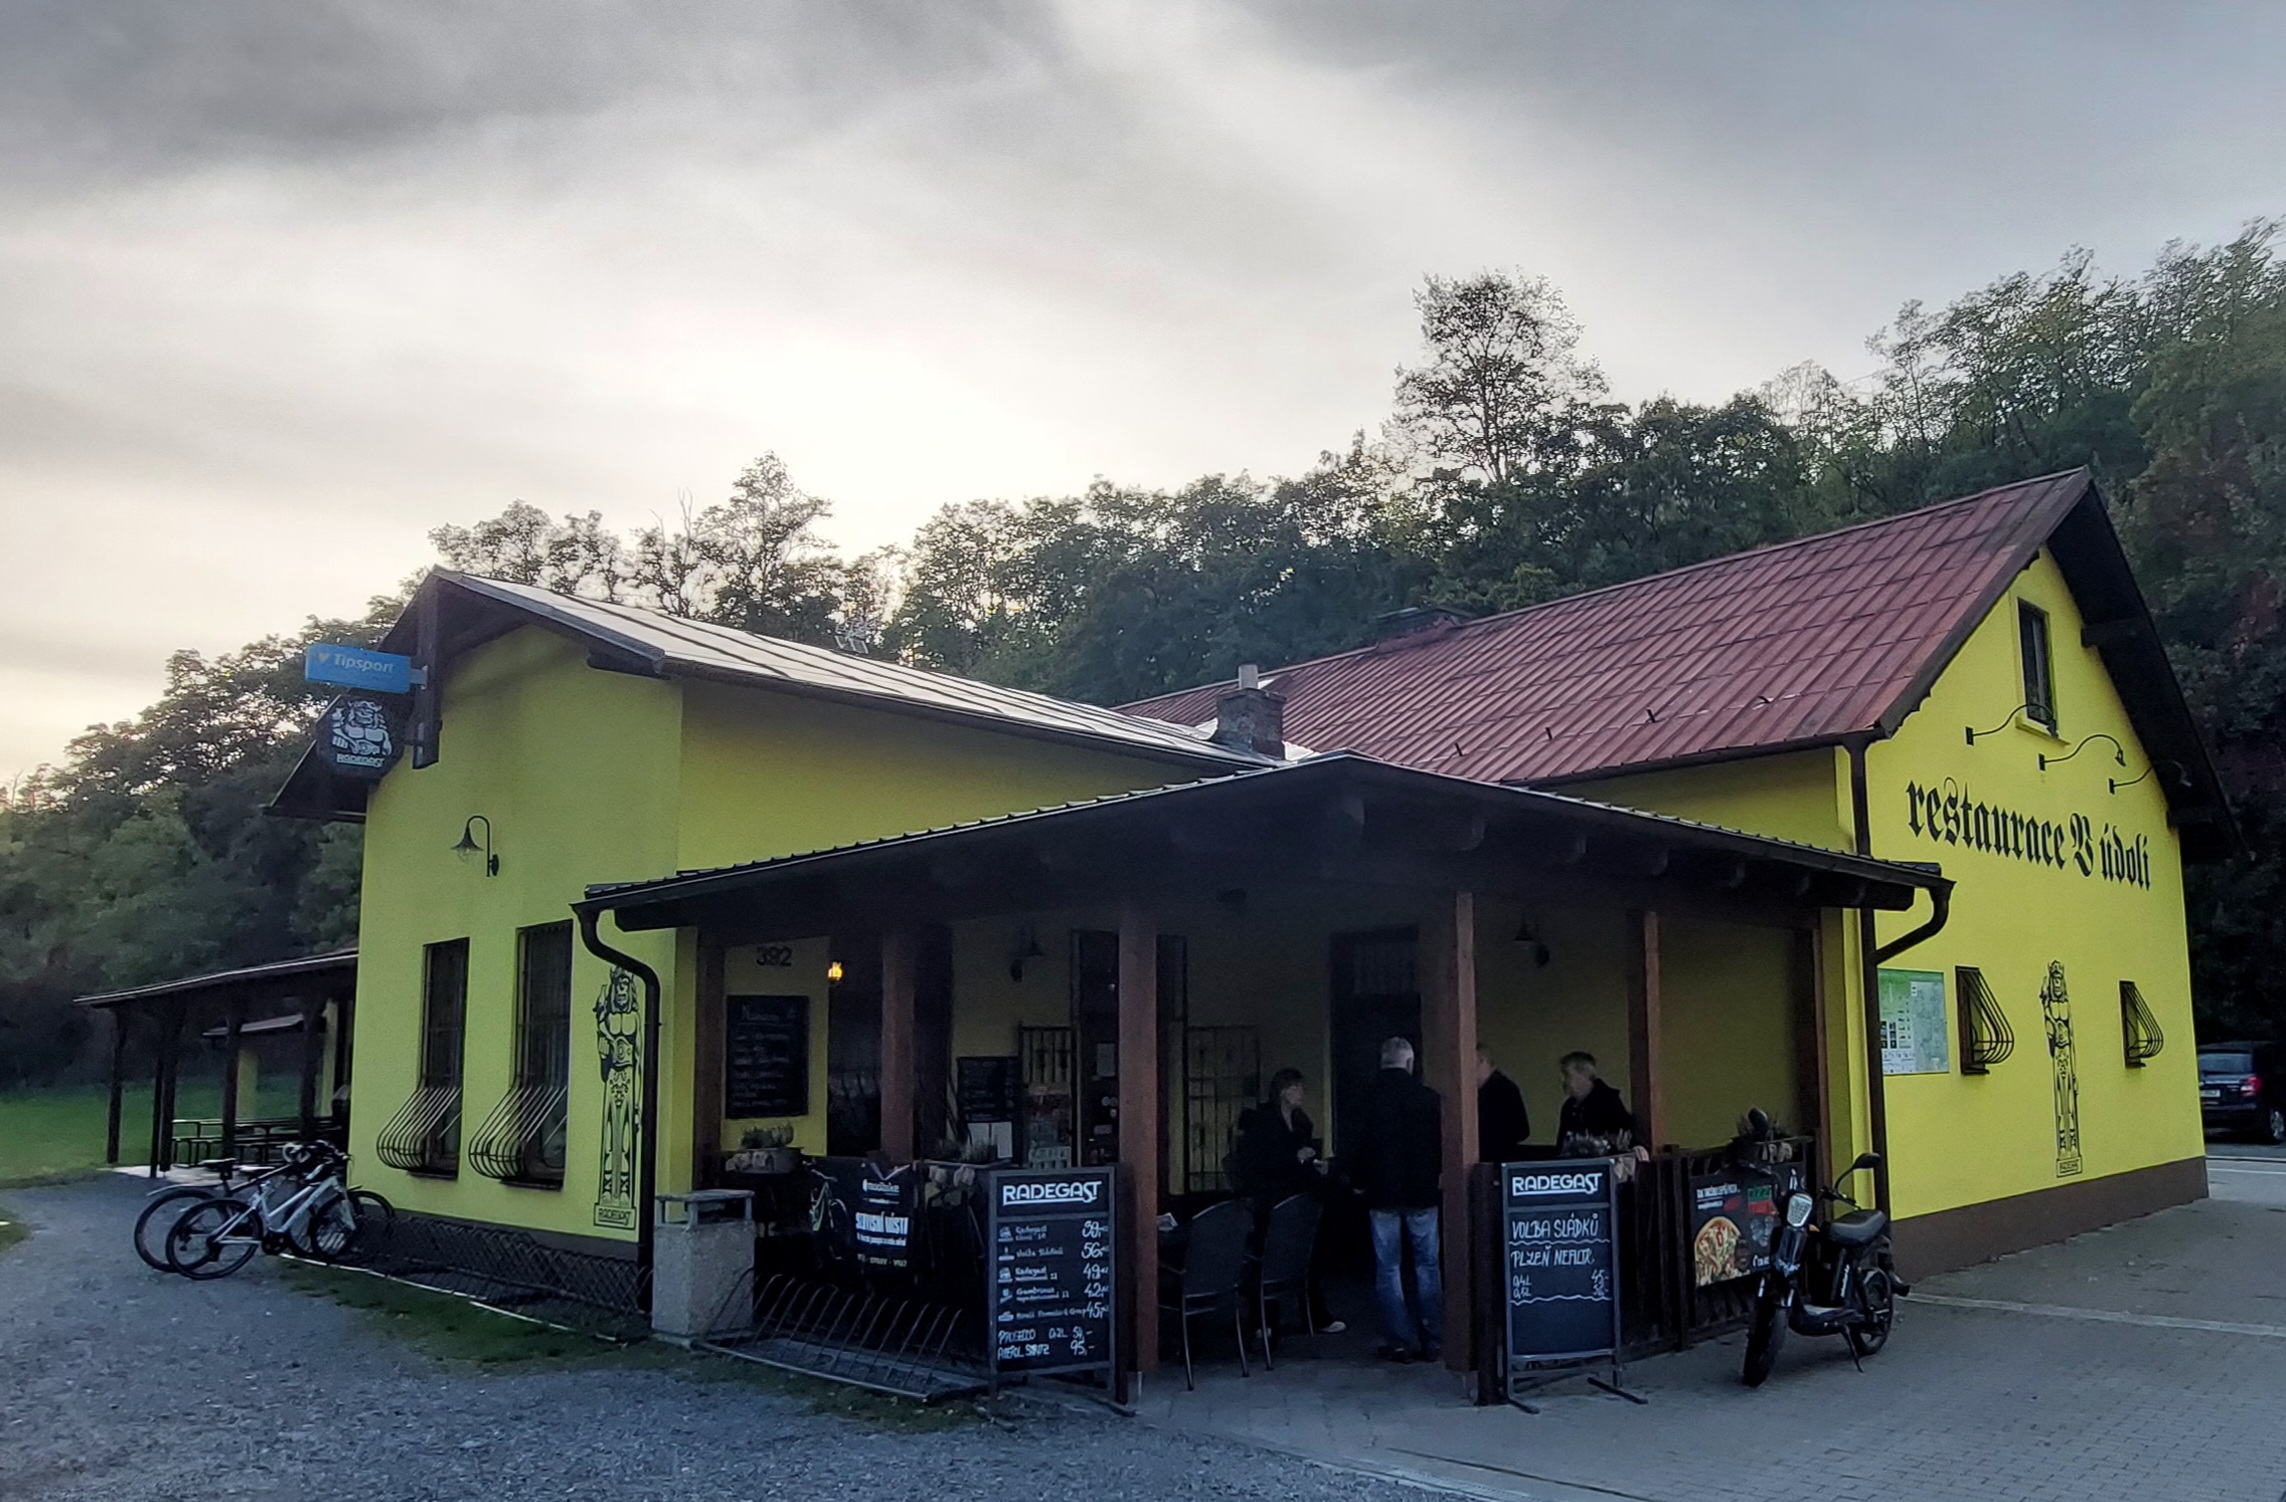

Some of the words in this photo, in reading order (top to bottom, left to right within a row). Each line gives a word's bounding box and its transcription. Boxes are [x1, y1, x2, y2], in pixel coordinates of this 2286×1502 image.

[333, 653, 394, 673] Tipsport
[1906, 776, 2066, 870] restaurace
[2099, 822, 2151, 891] údolí
[1002, 1181, 1102, 1206] RADEGAST
[1512, 1173, 1603, 1196] RADEGAST
[1512, 1220, 1551, 1240] VOLBA
[1553, 1212, 1599, 1238] SLÁDKŮ
[1510, 1245, 1552, 1268] PLZEŇ
